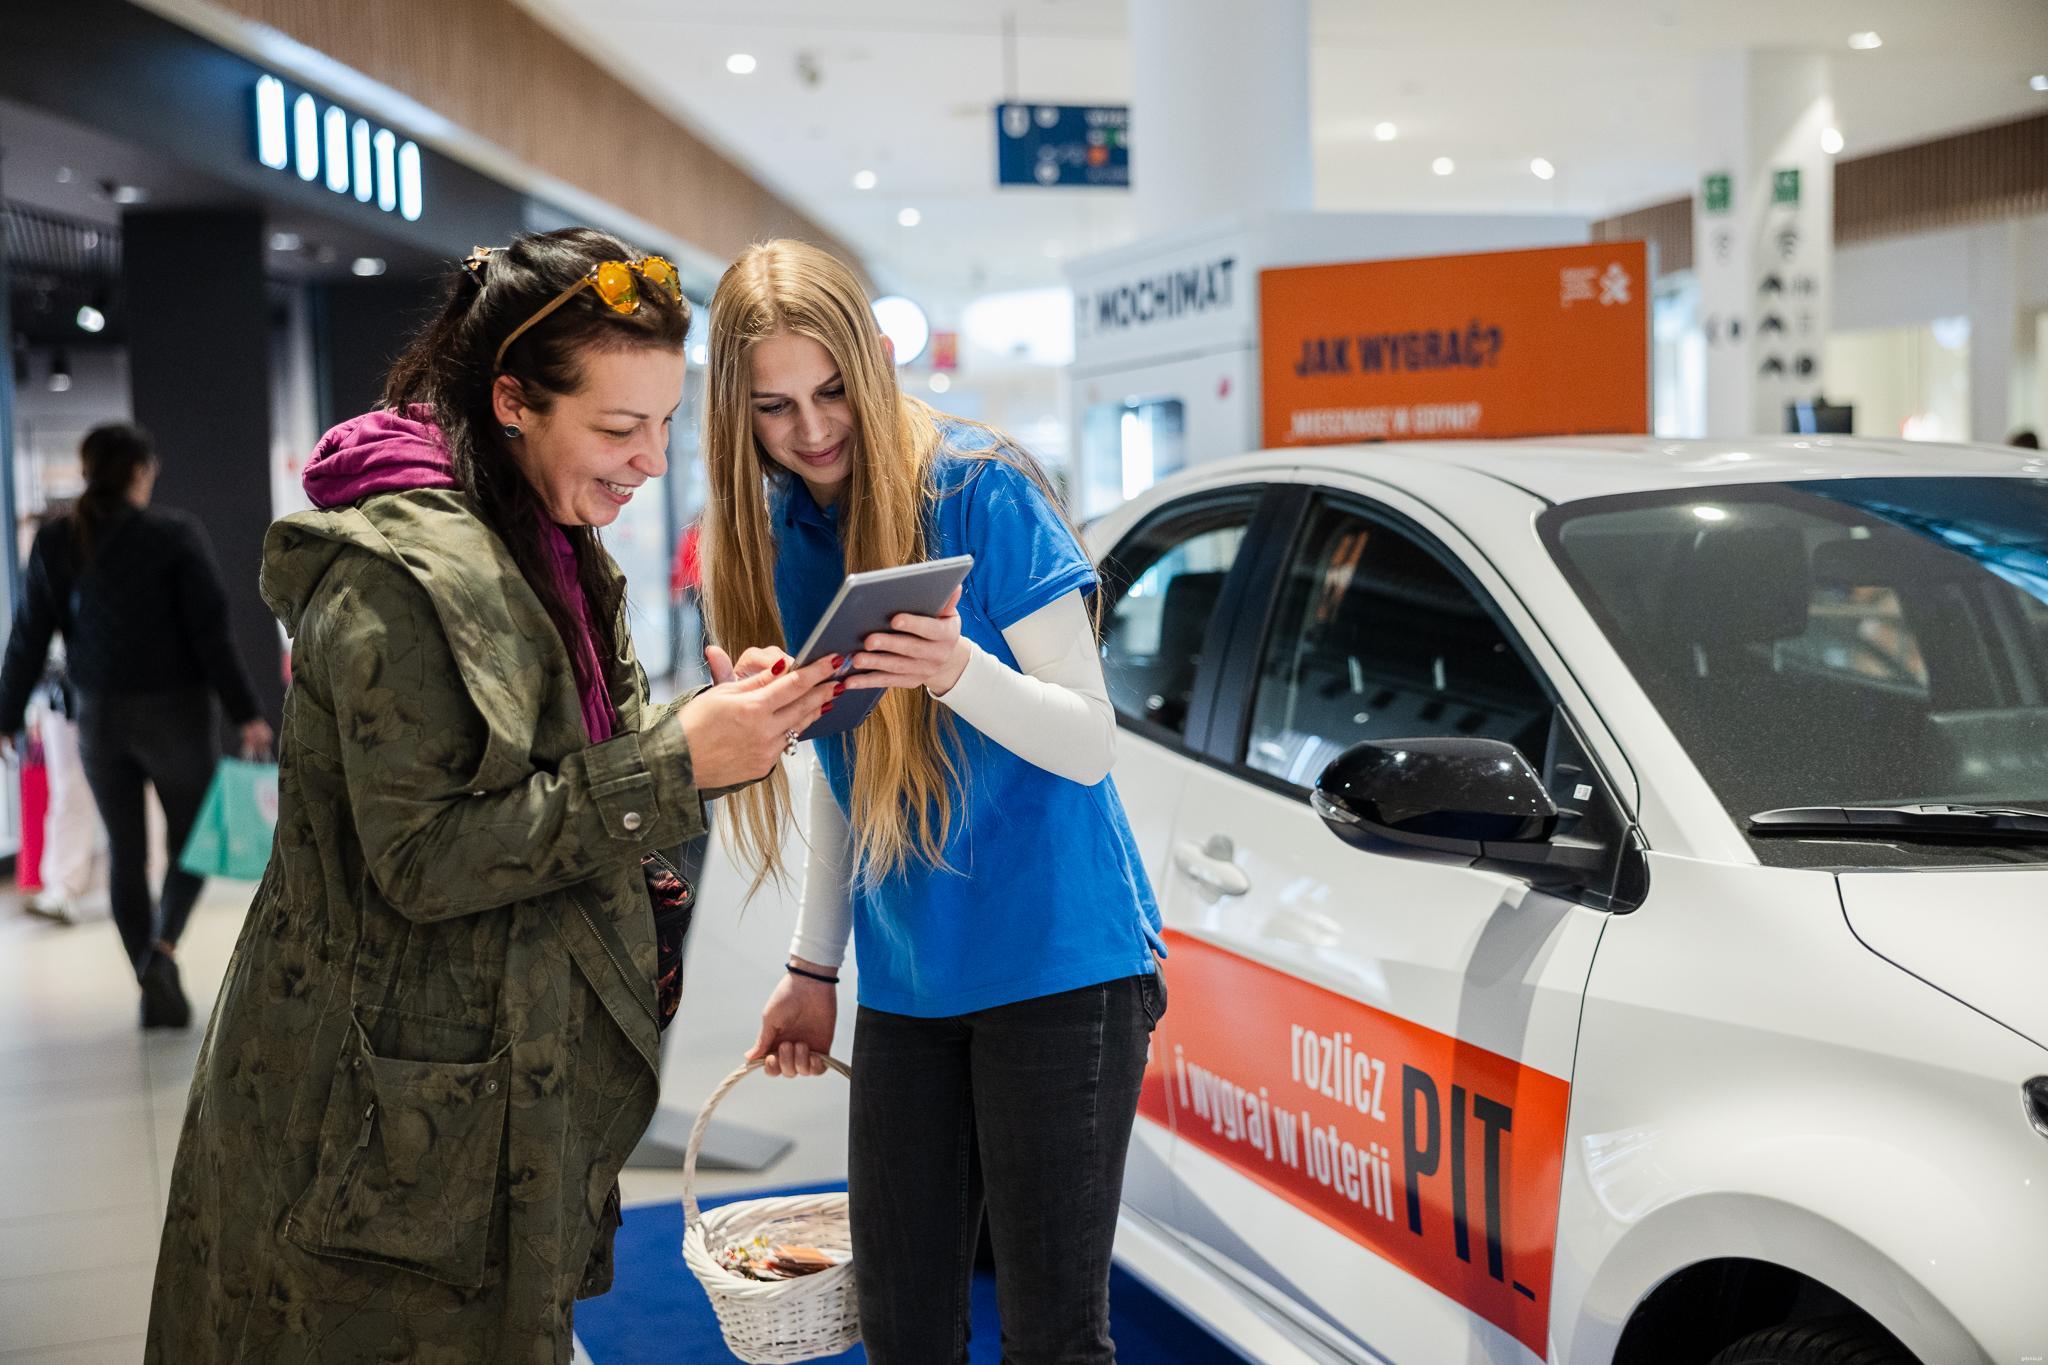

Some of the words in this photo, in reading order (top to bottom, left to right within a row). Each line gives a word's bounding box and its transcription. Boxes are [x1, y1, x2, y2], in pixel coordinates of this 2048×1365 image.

[1297, 338, 1350, 377] JAK
[1291, 1023, 1386, 1122] rozlicz
[1174, 1043, 1189, 1109] i
[1187, 1062, 1273, 1161] wygraj
[1273, 1106, 1298, 1169] w
[1302, 1110, 1394, 1222] loterii
